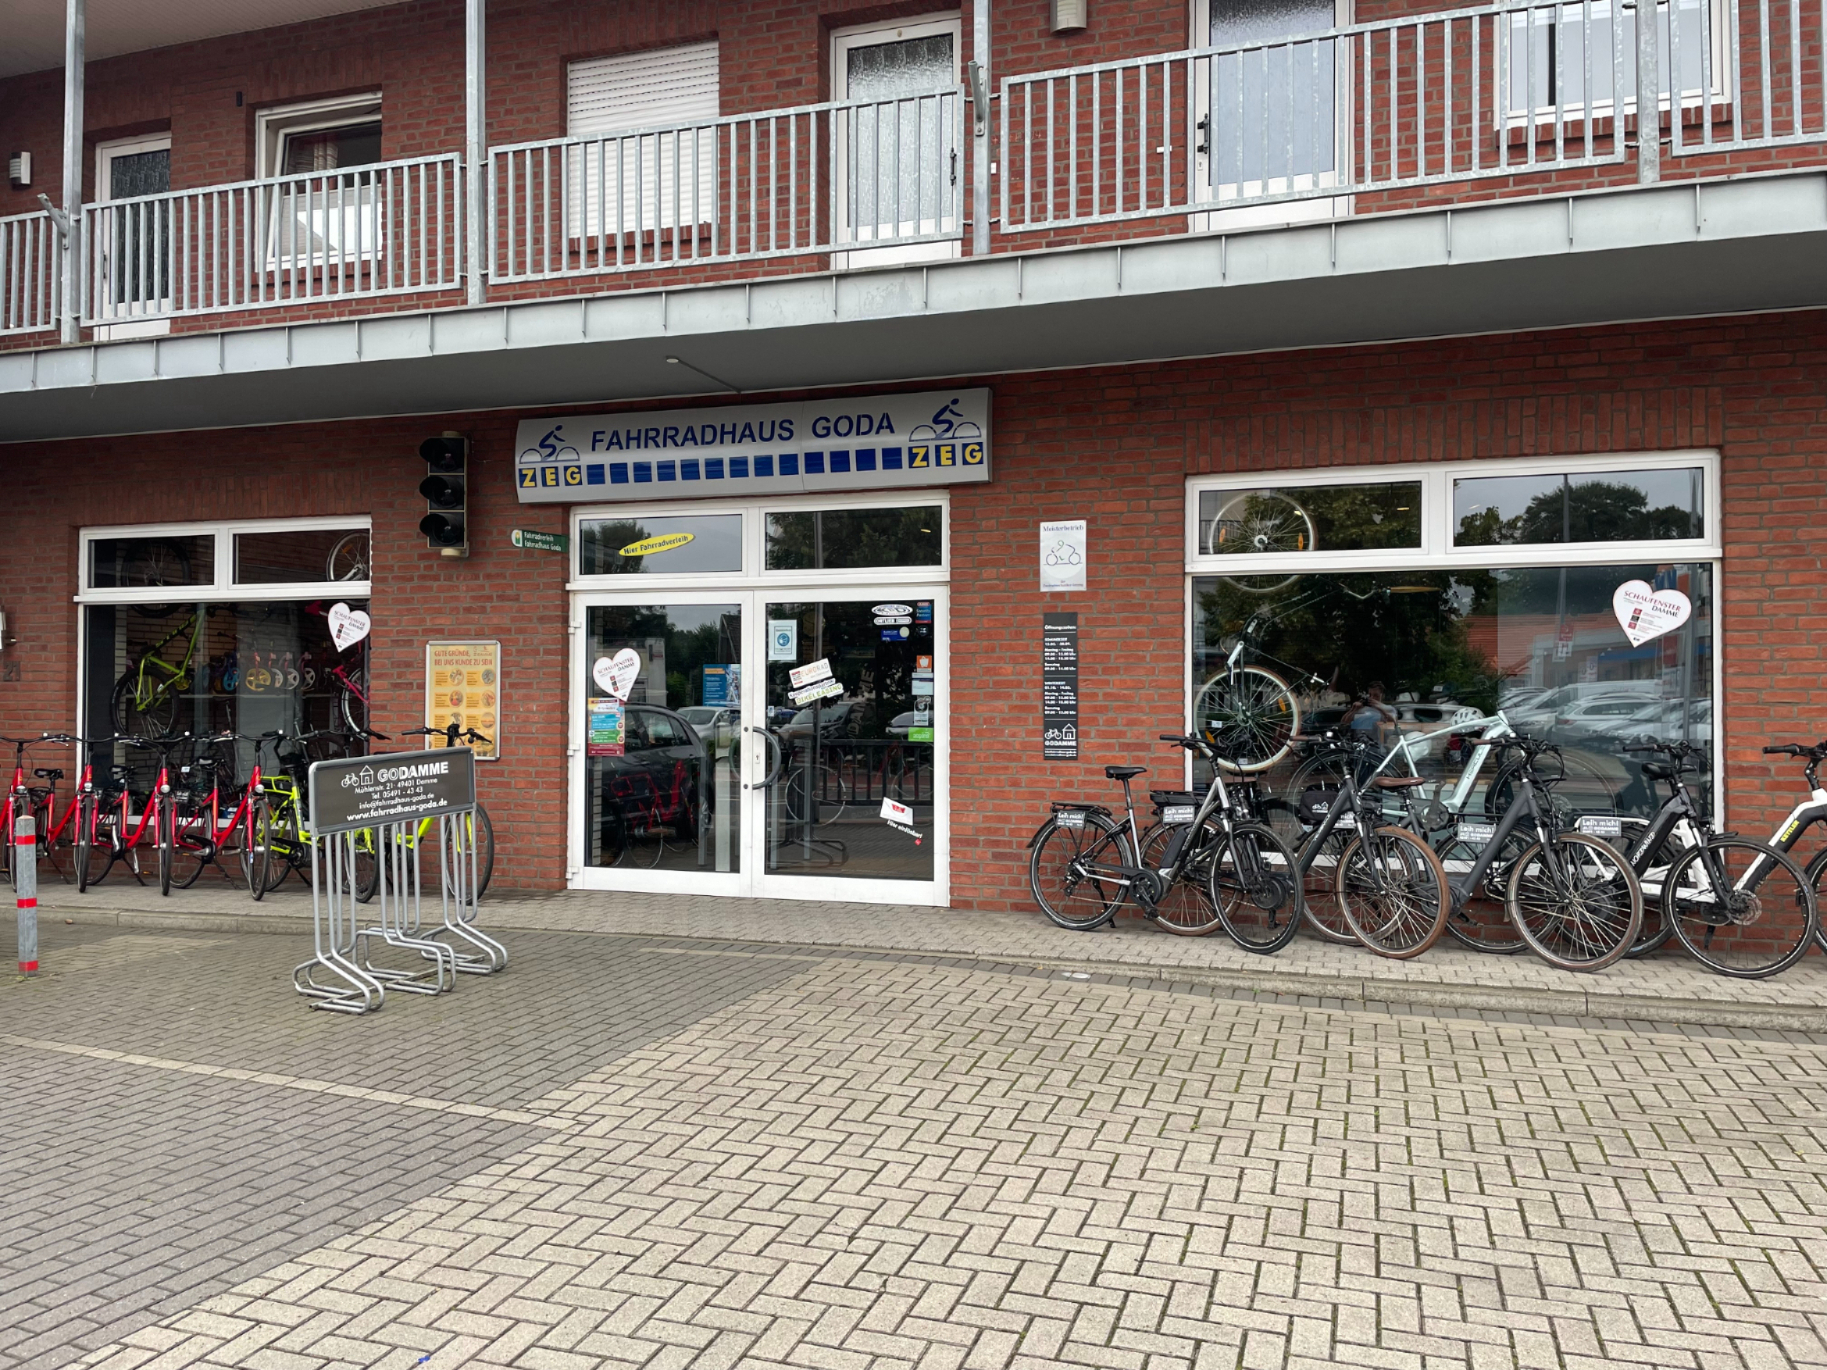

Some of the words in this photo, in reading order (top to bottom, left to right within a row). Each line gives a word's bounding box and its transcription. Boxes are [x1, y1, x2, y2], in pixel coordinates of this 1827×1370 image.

[591, 419, 794, 451] FAHRRADHAUS
[811, 412, 895, 438] GODA
[911, 444, 982, 467] ZEG
[521, 466, 581, 487] ZEG
[524, 531, 554, 542] Fahrradverleih
[1043, 524, 1084, 532] Meisterbetrieb
[524, 540, 550, 550] Fahrradhaus
[550, 544, 562, 552] Goda
[623, 547, 638, 555] Hier
[640, 535, 689, 551] Fahrradverleih
[1624, 590, 1681, 612] SCHAUFENSTER
[1652, 605, 1679, 618] DAMME
[448, 649, 471, 657] GRÜNDE,
[3, 661, 21, 681] 21
[801, 662, 829, 677] EURORAD
[796, 684, 842, 704] BIKELEASING
[377, 761, 449, 783] GODAMME
[355, 784, 384, 794] Mühlenstr.
[397, 780, 415, 788] 49401
[383, 790, 401, 799] 05491
[347, 798, 448, 821] www.fahrradhaus-goda.de
[359, 792, 434, 810] info@fahrradhaus-goda.de
[1475, 825, 1495, 833] mich!
[1599, 819, 1619, 827] mich!
[1780, 819, 1800, 843] KETTLER
